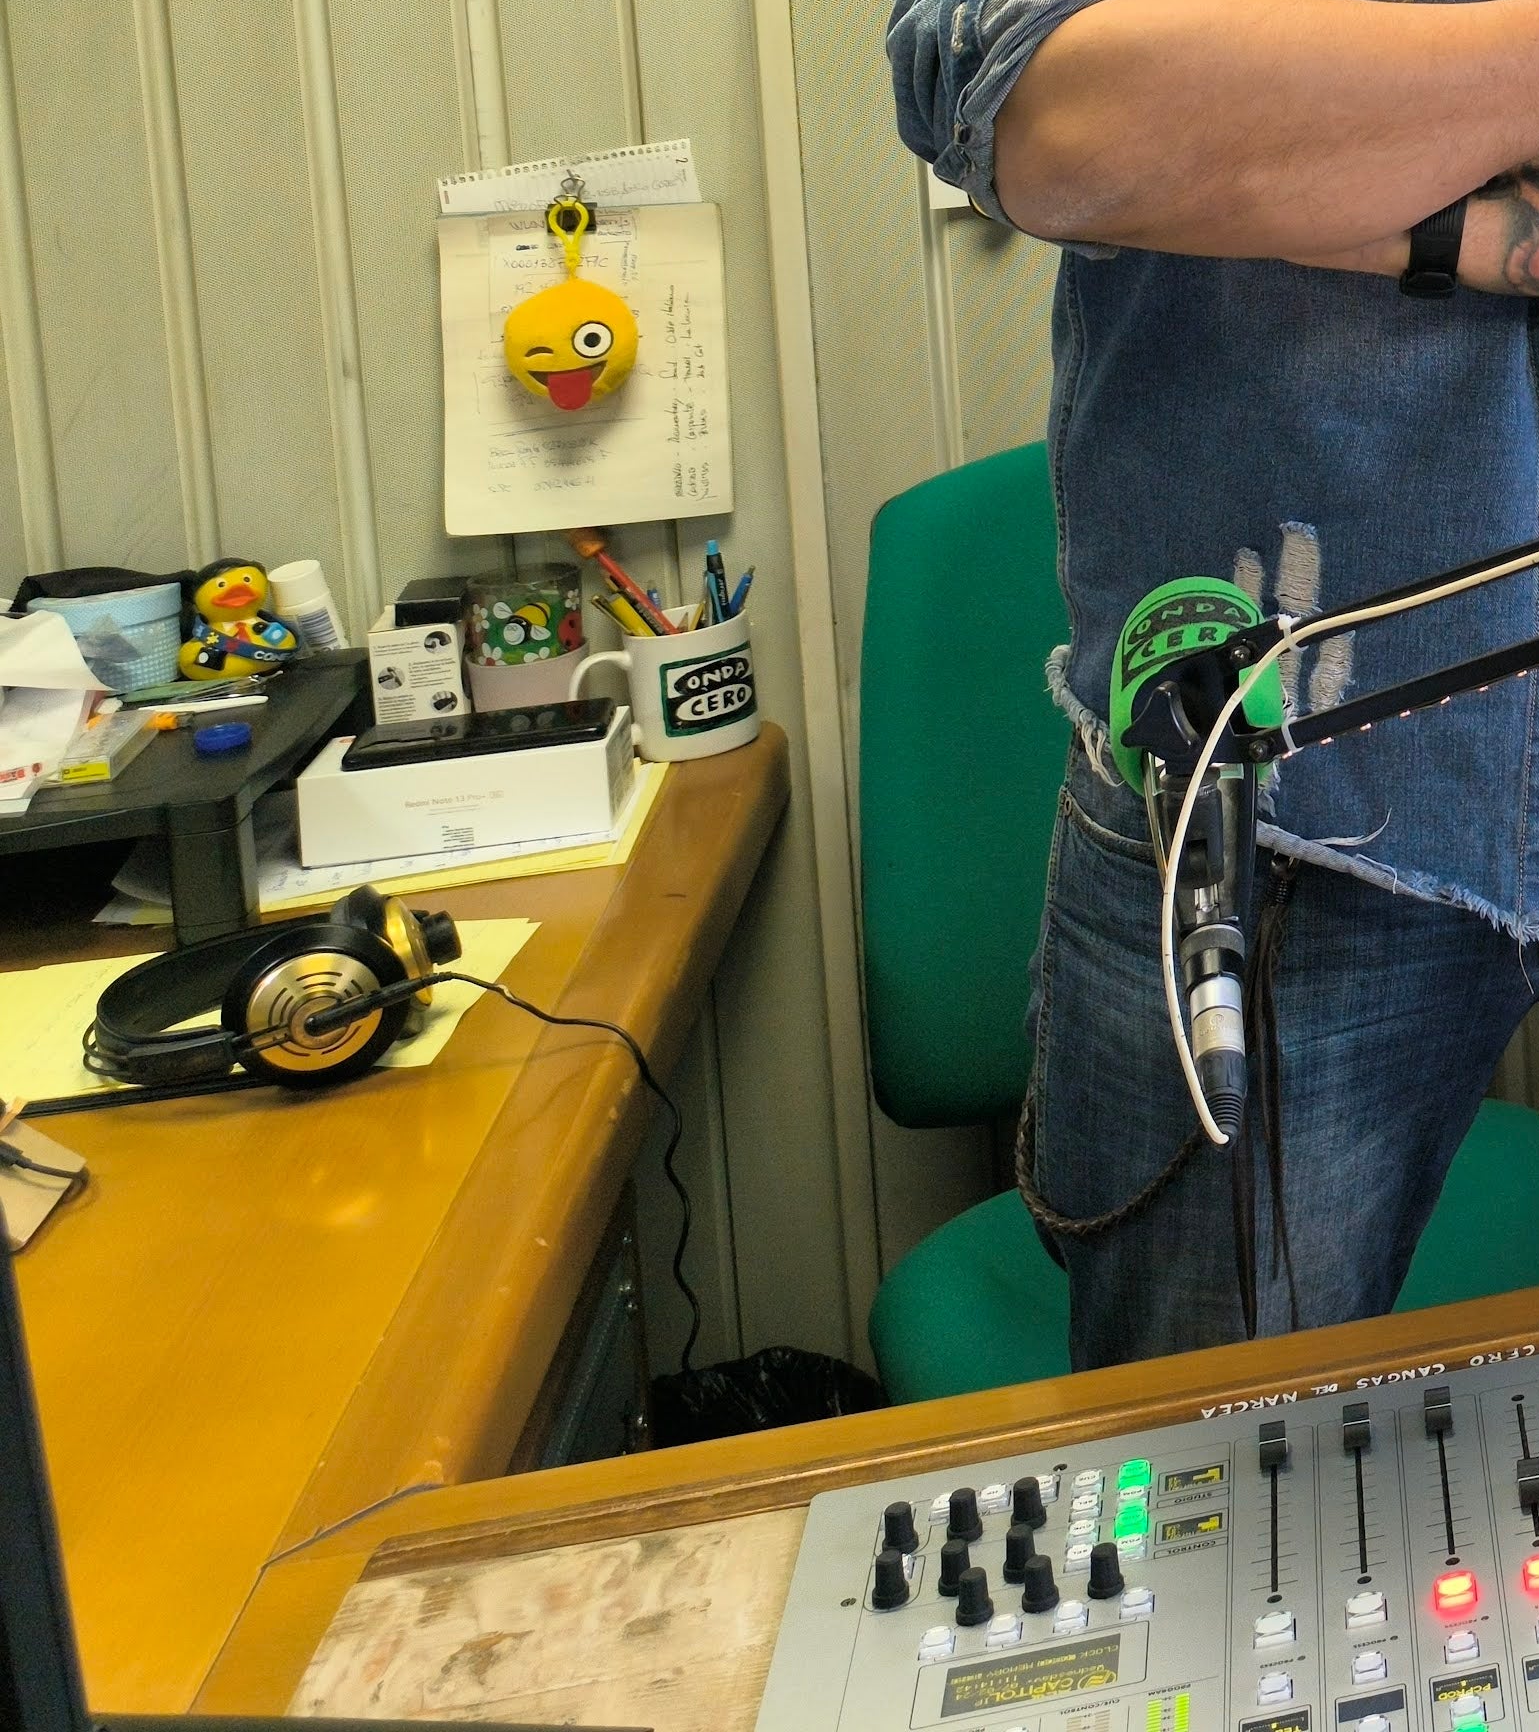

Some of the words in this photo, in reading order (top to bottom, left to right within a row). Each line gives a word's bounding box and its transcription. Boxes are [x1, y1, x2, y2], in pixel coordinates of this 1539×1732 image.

[1136, 602, 1241, 634] ONDA
[687, 661, 745, 690] ONDA
[691, 687, 746, 716] CERO
[1311, 1383, 1339, 1395] DEL
[1356, 1363, 1446, 1389] CANGAS
[1201, 1391, 1299, 1419] NARCEA
[1167, 1540, 1216, 1555] CONTROL
[1079, 1644, 1119, 1660] CLOCK
[992, 1677, 1074, 1703] CAPITOL
[1438, 1682, 1492, 1701] PCPROD
